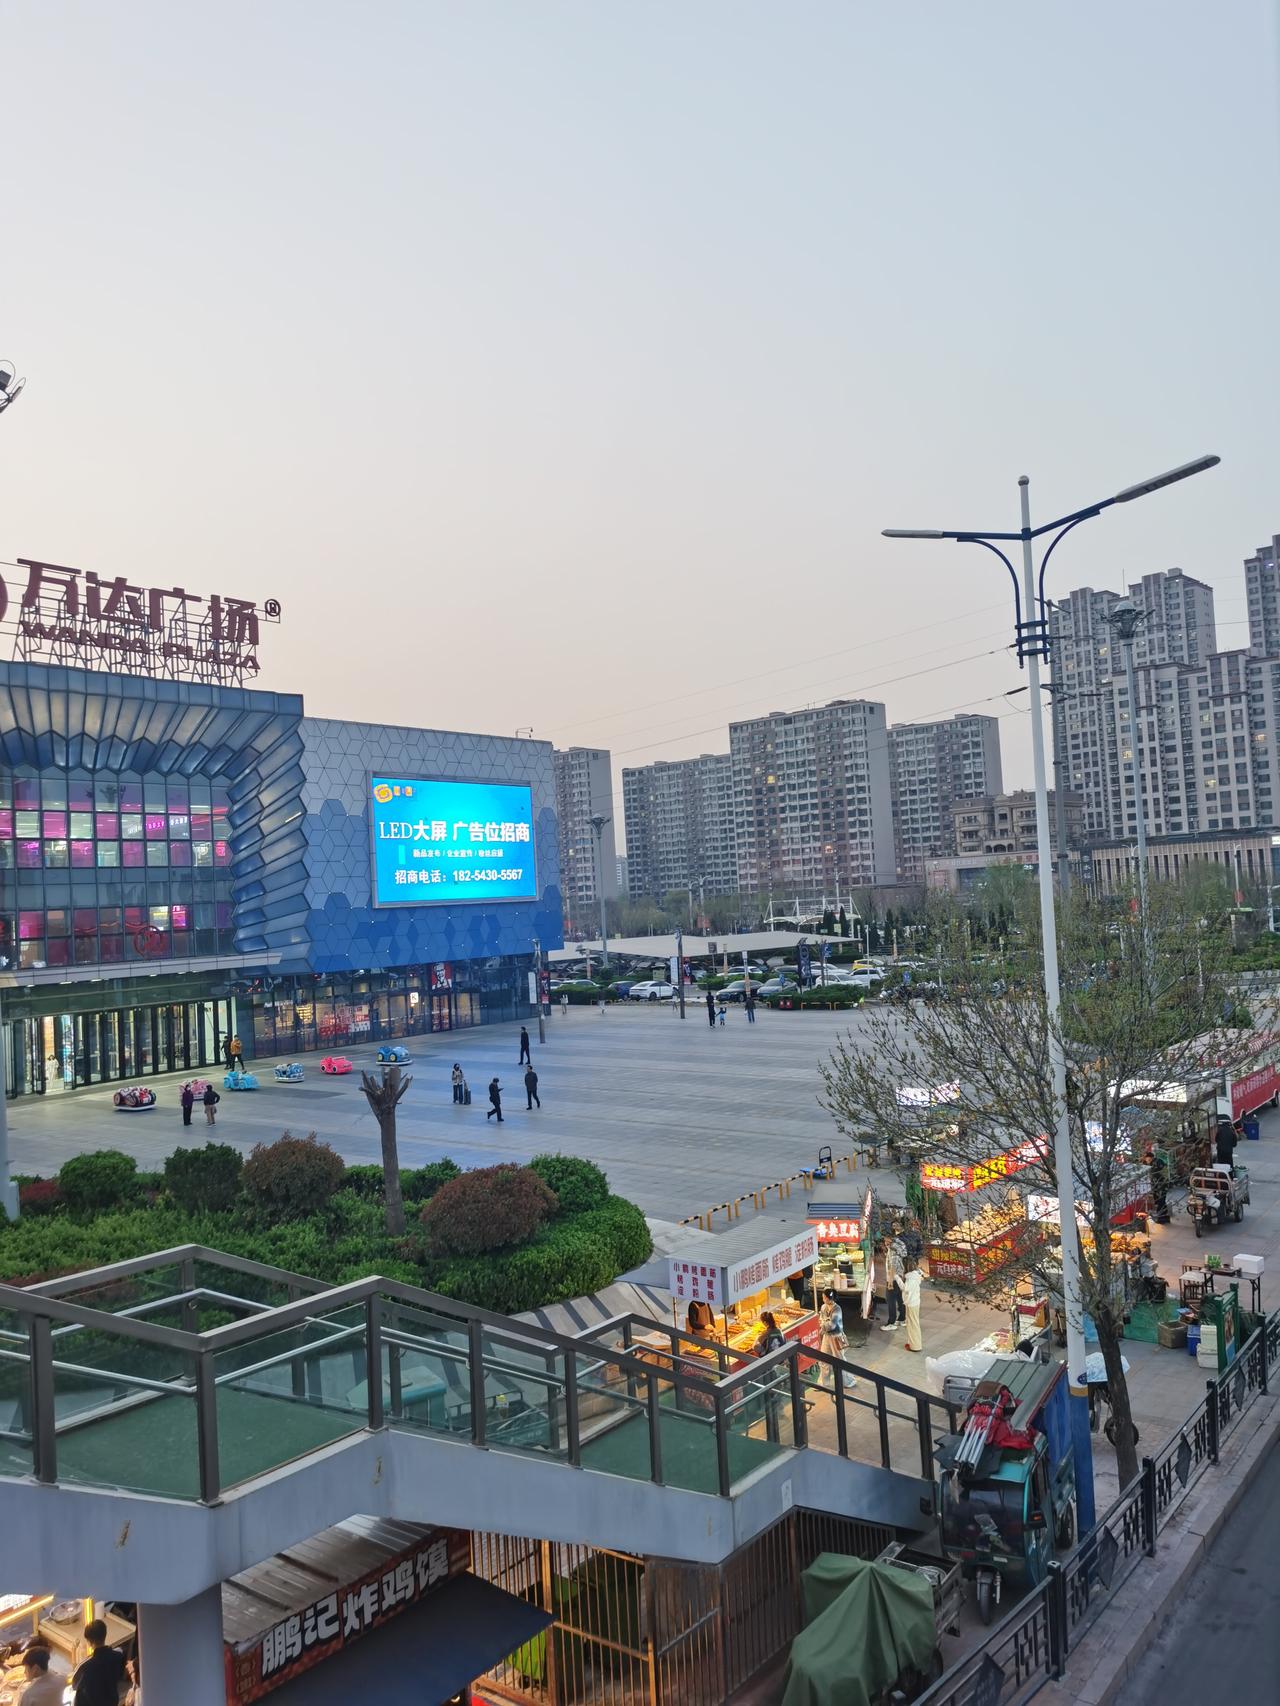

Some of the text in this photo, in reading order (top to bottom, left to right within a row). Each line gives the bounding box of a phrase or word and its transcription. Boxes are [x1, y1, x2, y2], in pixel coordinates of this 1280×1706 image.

[17, 558, 259, 645] 万达广场
[20, 620, 261, 670] WANDA PLAZA
[379, 820, 530, 842] LED大屏 广告位招商
[453, 869, 523, 882] 182-5430-5567
[262, 1538, 449, 1678] 鹏记炸鸡馍
